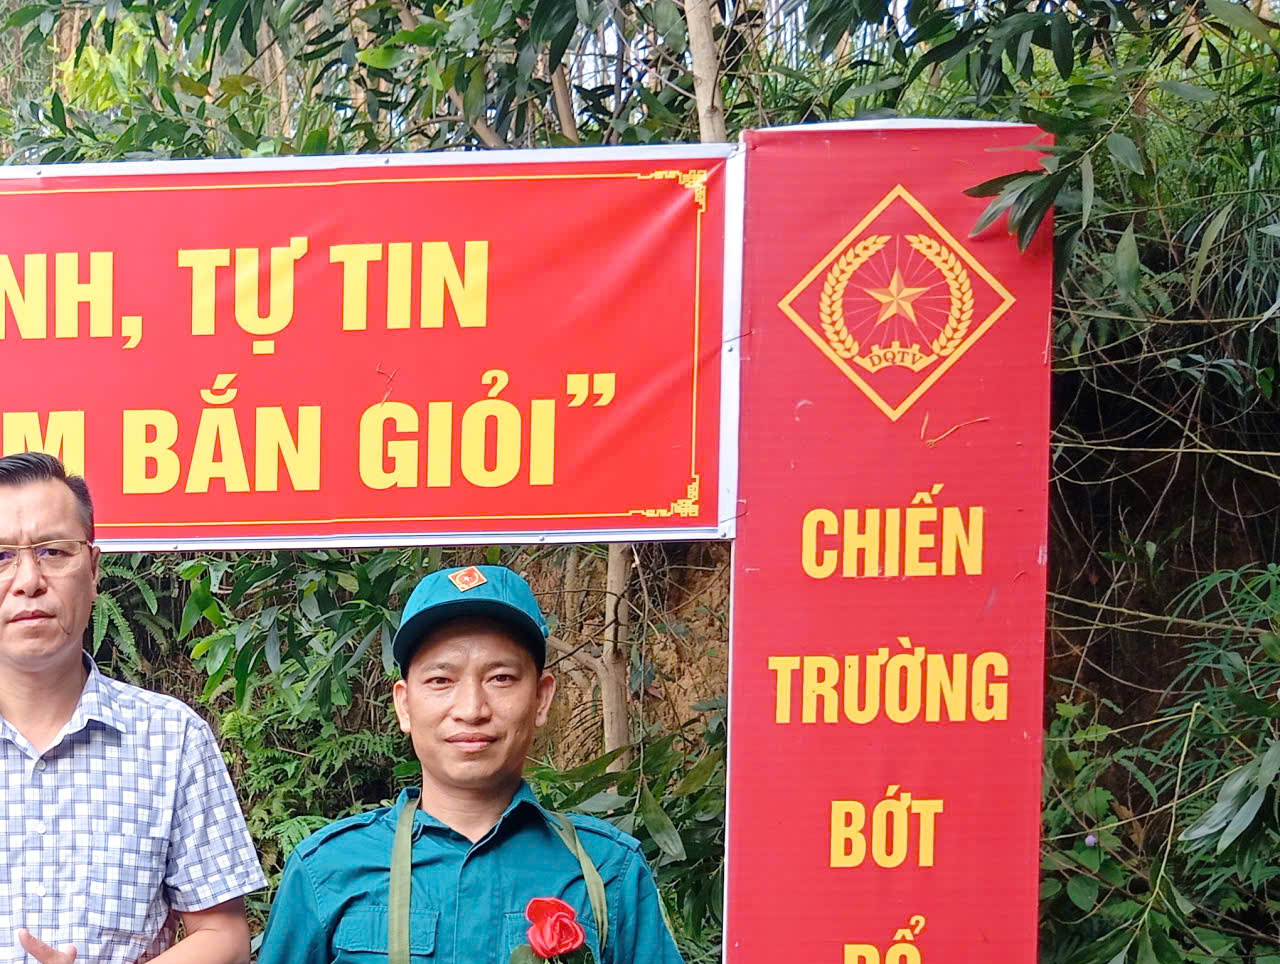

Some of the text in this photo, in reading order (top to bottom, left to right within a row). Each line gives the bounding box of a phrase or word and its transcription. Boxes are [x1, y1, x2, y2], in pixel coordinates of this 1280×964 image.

[177, 236, 308, 355] TỰ
[329, 240, 489, 331] TIN
[869, 350, 924, 367] DQTV
[122, 373, 321, 494] BẮN
[359, 369, 616, 490] GIỎI”
[801, 483, 983, 579] CHIẾN
[768, 636, 1009, 724] TRƯỜNG
[830, 785, 944, 868] BỚT
